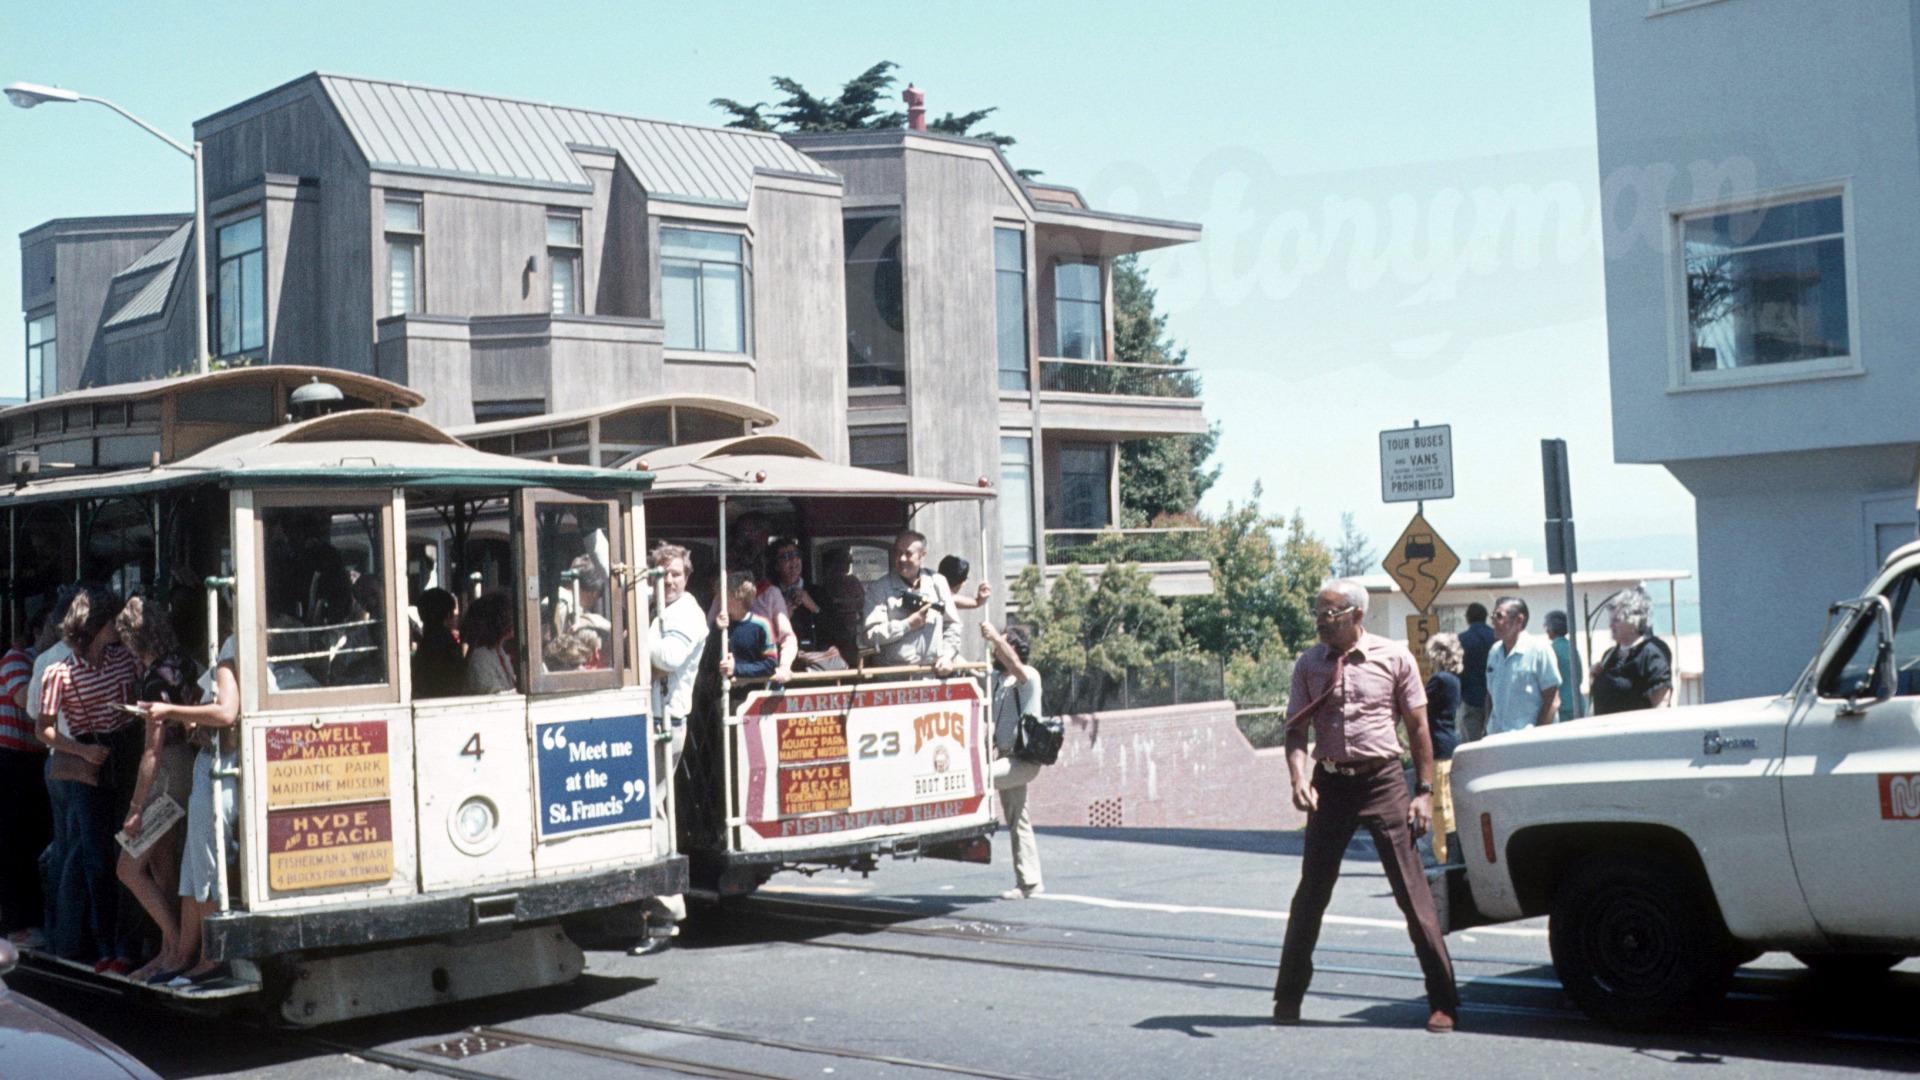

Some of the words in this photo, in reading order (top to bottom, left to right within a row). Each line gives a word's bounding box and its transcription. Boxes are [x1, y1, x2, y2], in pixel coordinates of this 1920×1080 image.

[1387, 438, 1410, 451] TOUR
[1414, 435, 1443, 448] BUSES
[1410, 453, 1438, 466] VANS
[1391, 478, 1444, 493] PROHIBITED
[1418, 620, 1429, 644] 5
[786, 692, 866, 713] MARKET
[873, 687, 940, 706] STREET
[292, 726, 363, 744] POWELL
[795, 724, 841, 737] MARKET
[913, 711, 965, 754] MUG
[282, 746, 299, 760] AND
[302, 742, 371, 760] MARKET
[460, 732, 485, 761] 4
[611, 741, 633, 757] me
[858, 731, 901, 760] 23
[273, 763, 334, 778] AQUATIC
[345, 760, 381, 773] PARK
[791, 766, 843, 780] HYDE
[272, 781, 331, 795] MARITIME
[336, 777, 385, 791] MUSEUM
[566, 772, 581, 792] at
[585, 768, 608, 790] the
[800, 778, 849, 793] BEACH
[549, 803, 572, 824] St.
[912, 801, 964, 821] WHARF
[293, 811, 369, 831] HYDE
[284, 832, 302, 851] AND
[307, 827, 378, 847] BEACH
